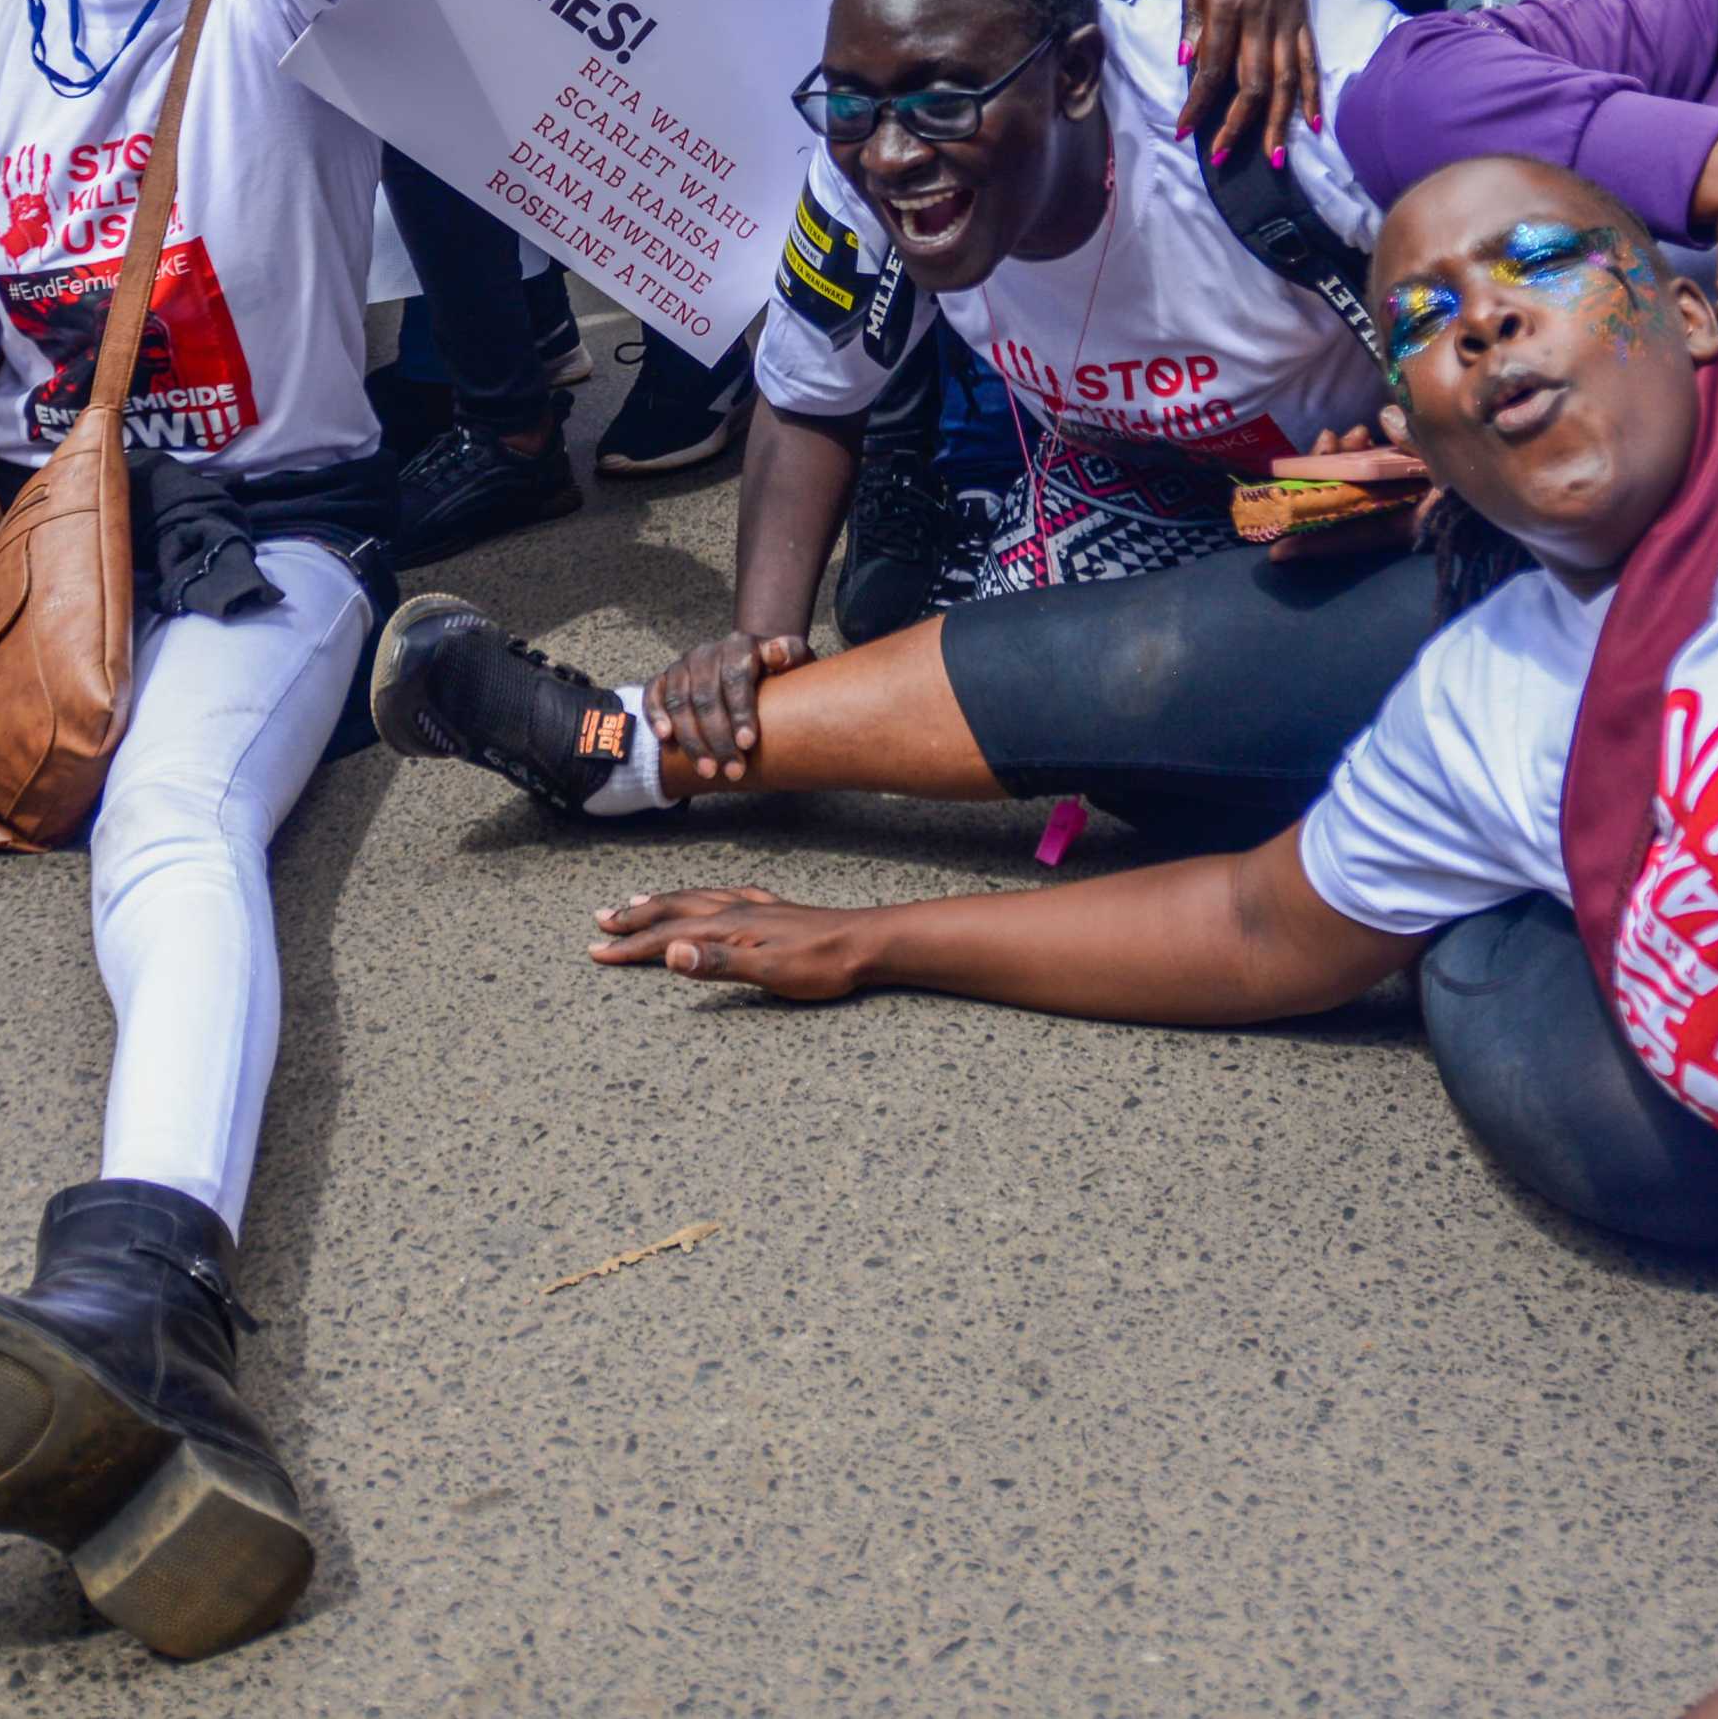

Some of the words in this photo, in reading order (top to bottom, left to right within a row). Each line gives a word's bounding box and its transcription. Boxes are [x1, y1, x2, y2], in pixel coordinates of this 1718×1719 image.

[67, 134, 159, 182] STO
[555, 86, 677, 178] SCARLET
[679, 171, 761, 242] WAHU
[579, 57, 643, 115] RITA
[649, 106, 738, 183] WAENI
[67, 176, 143, 216] KILL
[509, 141, 595, 213] DIANA
[599, 203, 714, 295] MWENDE
[531, 112, 629, 191] RAHAB
[629, 184, 723, 262] KARISA
[8, 252, 191, 302] #EndFemiceKE
[485, 169, 615, 269] ROSELINE
[615, 262, 713, 338] ATIENO
[121, 384, 237, 412] EMICIDE
[1075, 355, 1220, 404] STOP
